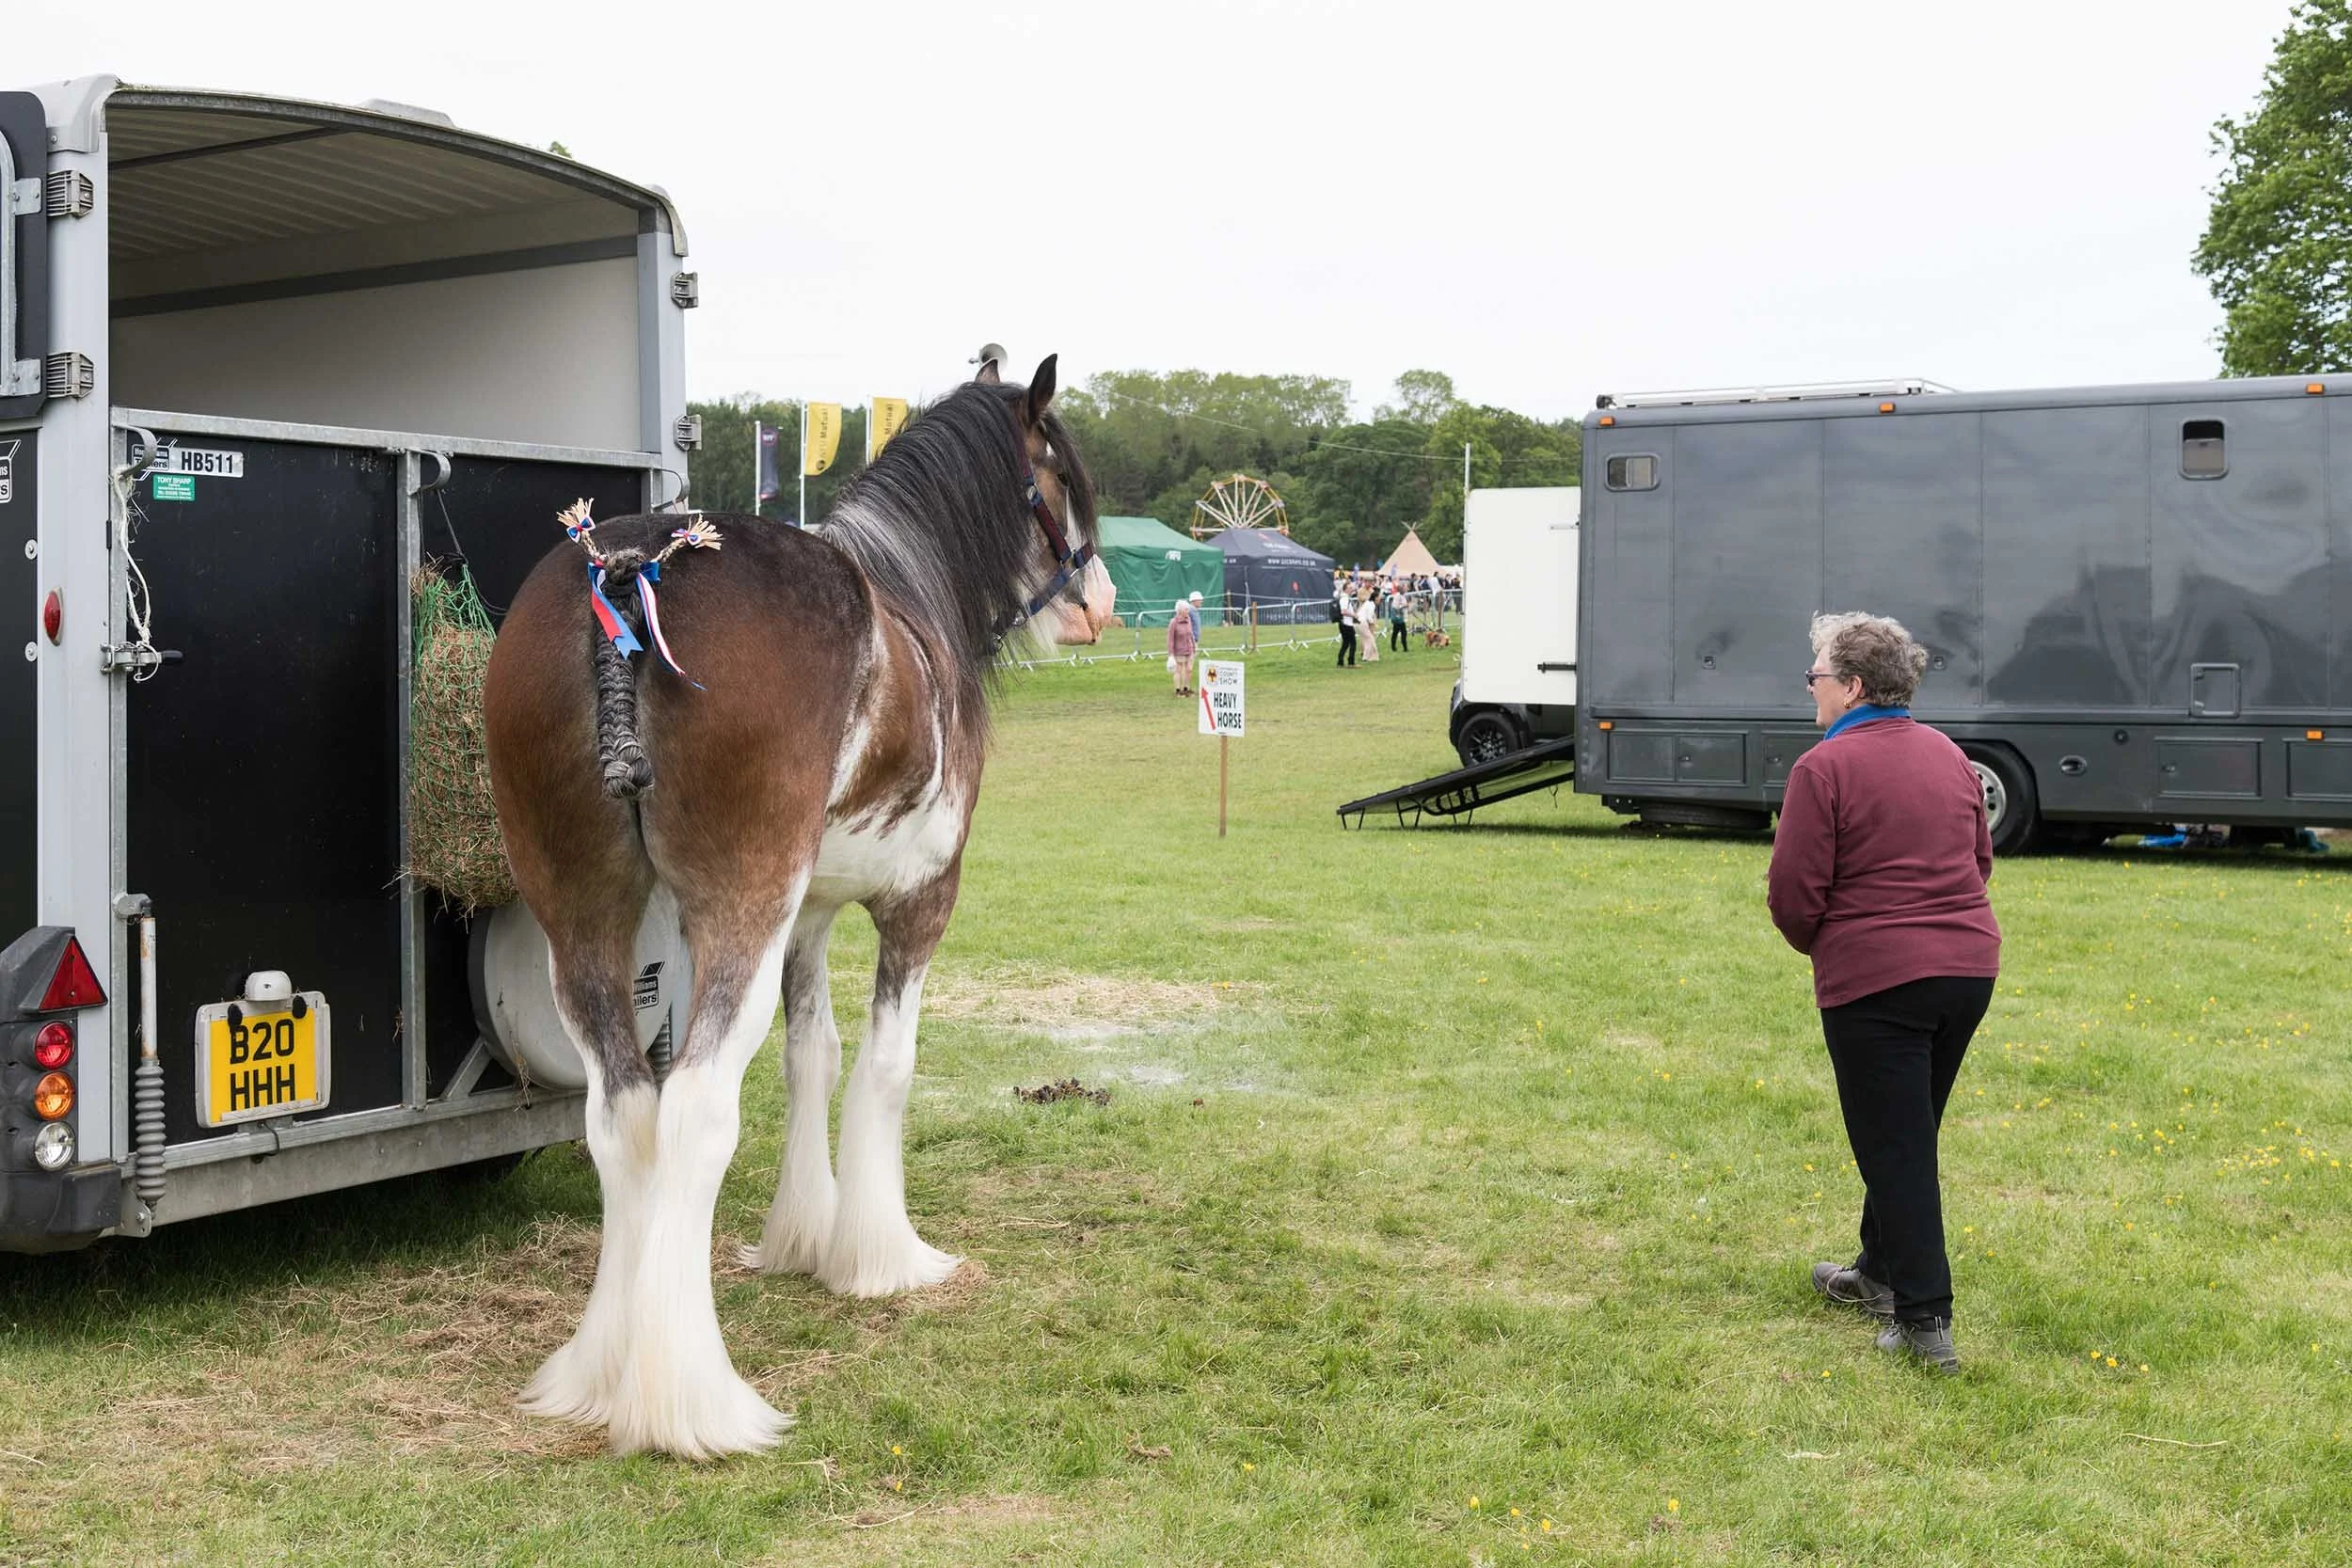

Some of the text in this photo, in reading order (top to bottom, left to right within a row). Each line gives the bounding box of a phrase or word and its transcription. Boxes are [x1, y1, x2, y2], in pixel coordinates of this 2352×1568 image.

[182, 451, 233, 473] HB511
[1214, 692, 1237, 708] HEAVY
[1217, 712, 1241, 729] HORSE
[230, 1019, 294, 1064] B20
[230, 1064, 295, 1111] HHH
